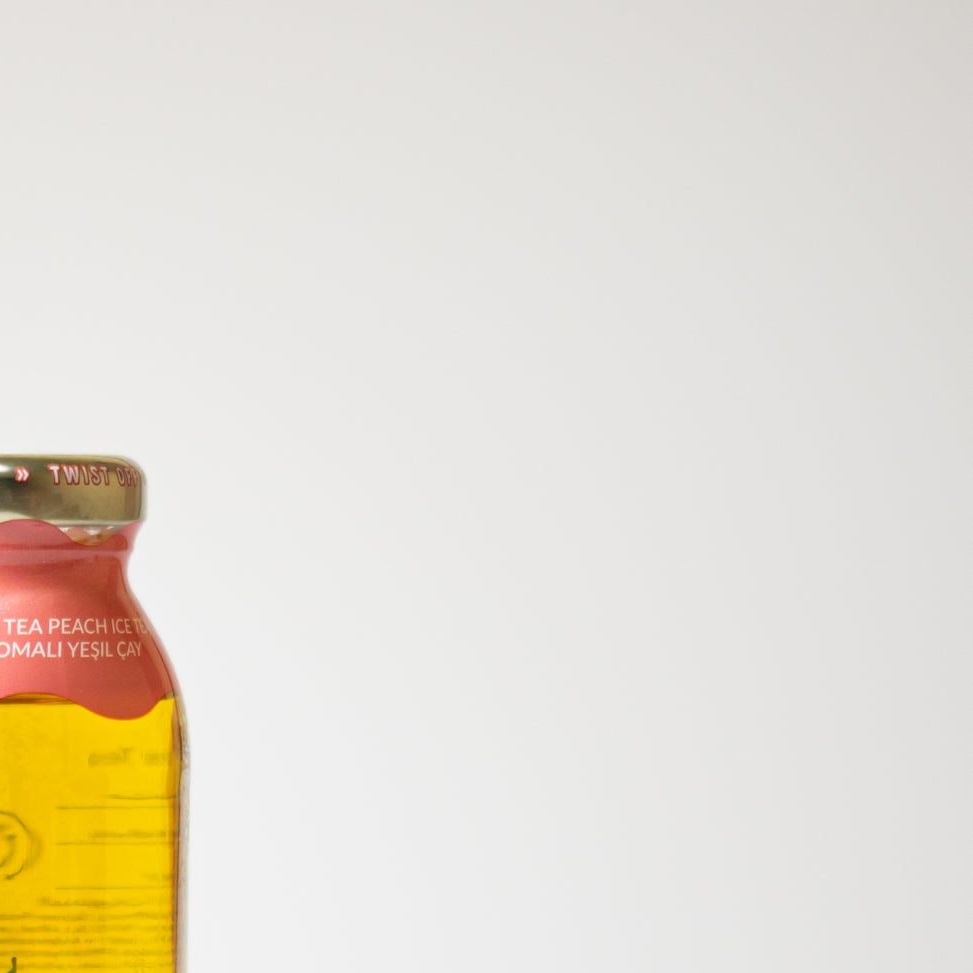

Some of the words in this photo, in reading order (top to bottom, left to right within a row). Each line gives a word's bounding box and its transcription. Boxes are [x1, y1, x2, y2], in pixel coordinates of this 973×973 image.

[48, 463, 111, 486] TWIST
[3, 618, 43, 635] TEA
[48, 618, 108, 635] PEACH
[111, 618, 132, 634] ICE
[116, 641, 141, 661] ÇAY
